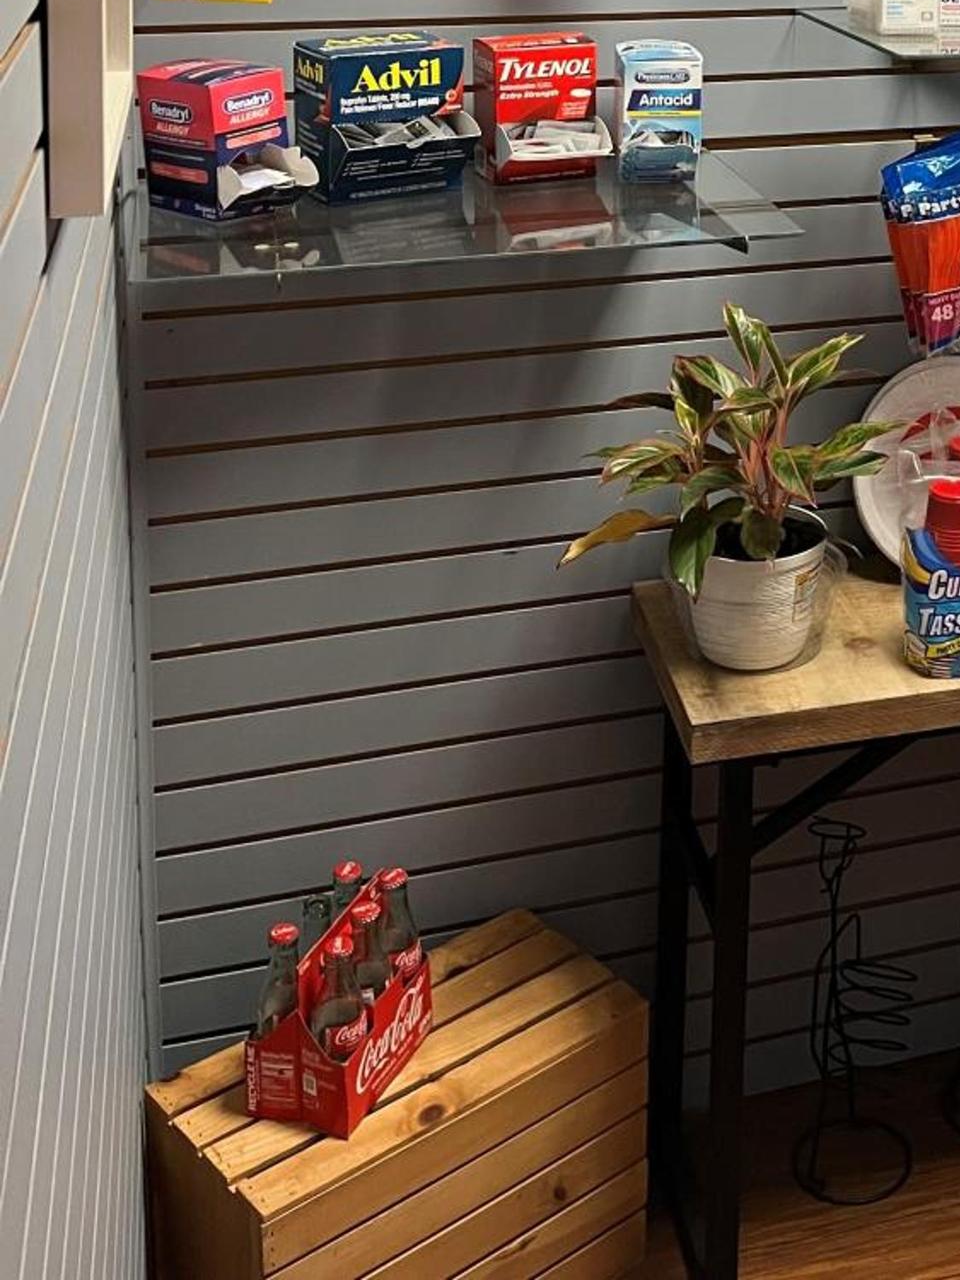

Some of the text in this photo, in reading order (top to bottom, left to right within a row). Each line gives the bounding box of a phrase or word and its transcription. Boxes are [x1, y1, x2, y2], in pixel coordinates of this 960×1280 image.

[297, 58, 324, 84] Advil
[351, 57, 442, 93] Advil
[499, 57, 592, 82] TYLENOL
[226, 91, 270, 113] Benadryl
[500, 90, 522, 100] Extra
[639, 93, 694, 106] Antacid
[151, 102, 190, 122] Benadryl
[229, 108, 270, 125] ALLERGY
[156, 122, 191, 136] ALLERGY
[931, 304, 954, 322] 48
[355, 974, 425, 1095] Coca-Cola
